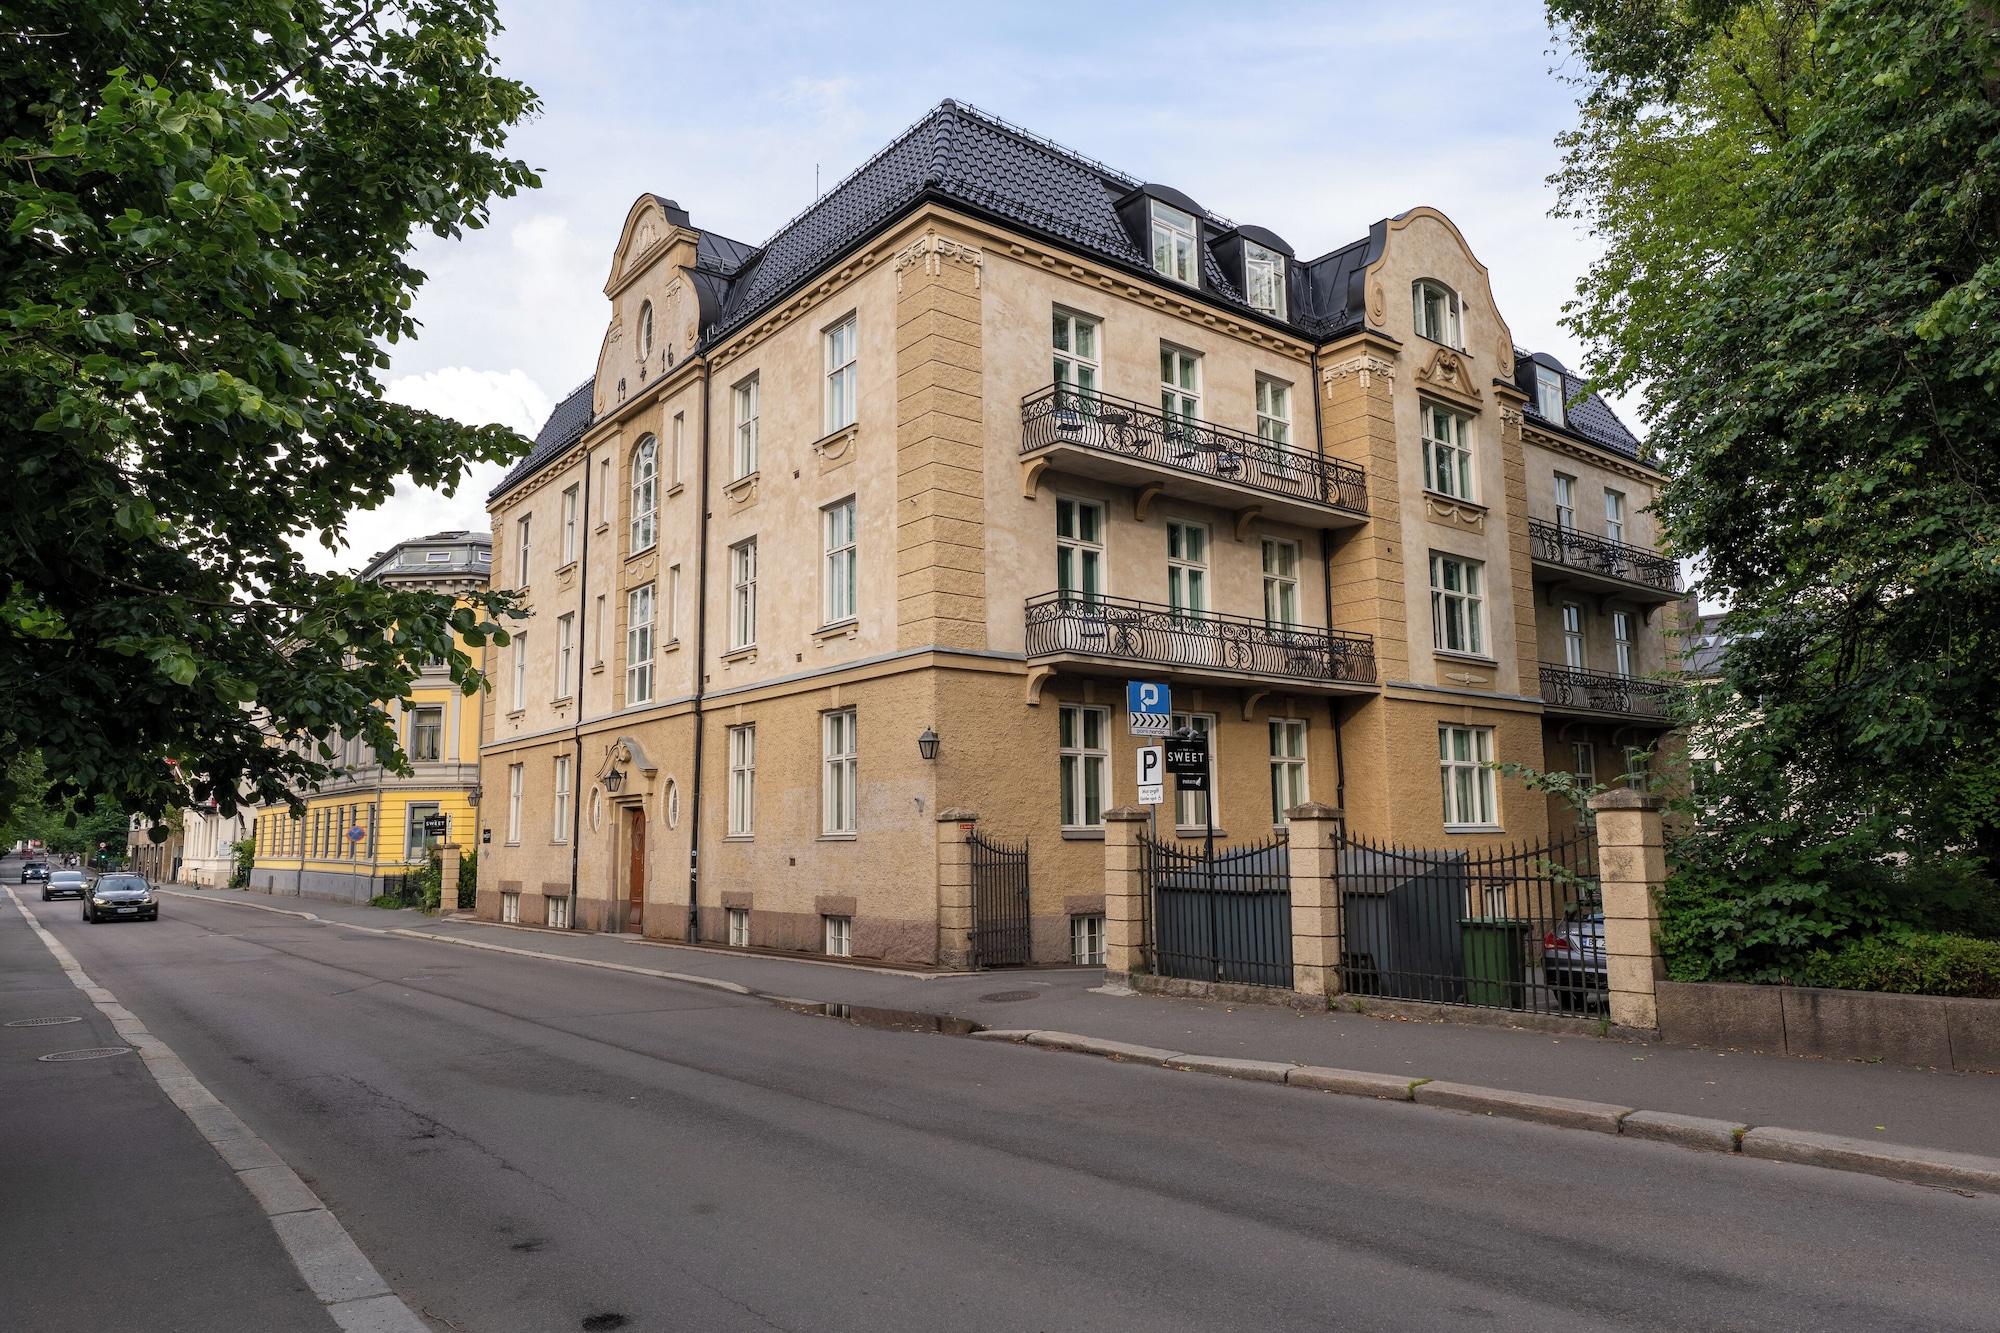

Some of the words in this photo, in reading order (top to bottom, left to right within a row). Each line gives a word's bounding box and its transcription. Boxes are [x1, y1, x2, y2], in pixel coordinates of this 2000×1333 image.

[662, 342, 674, 373] 16
[1143, 750, 1157, 781] P
[1167, 751, 1204, 763] SWEET
